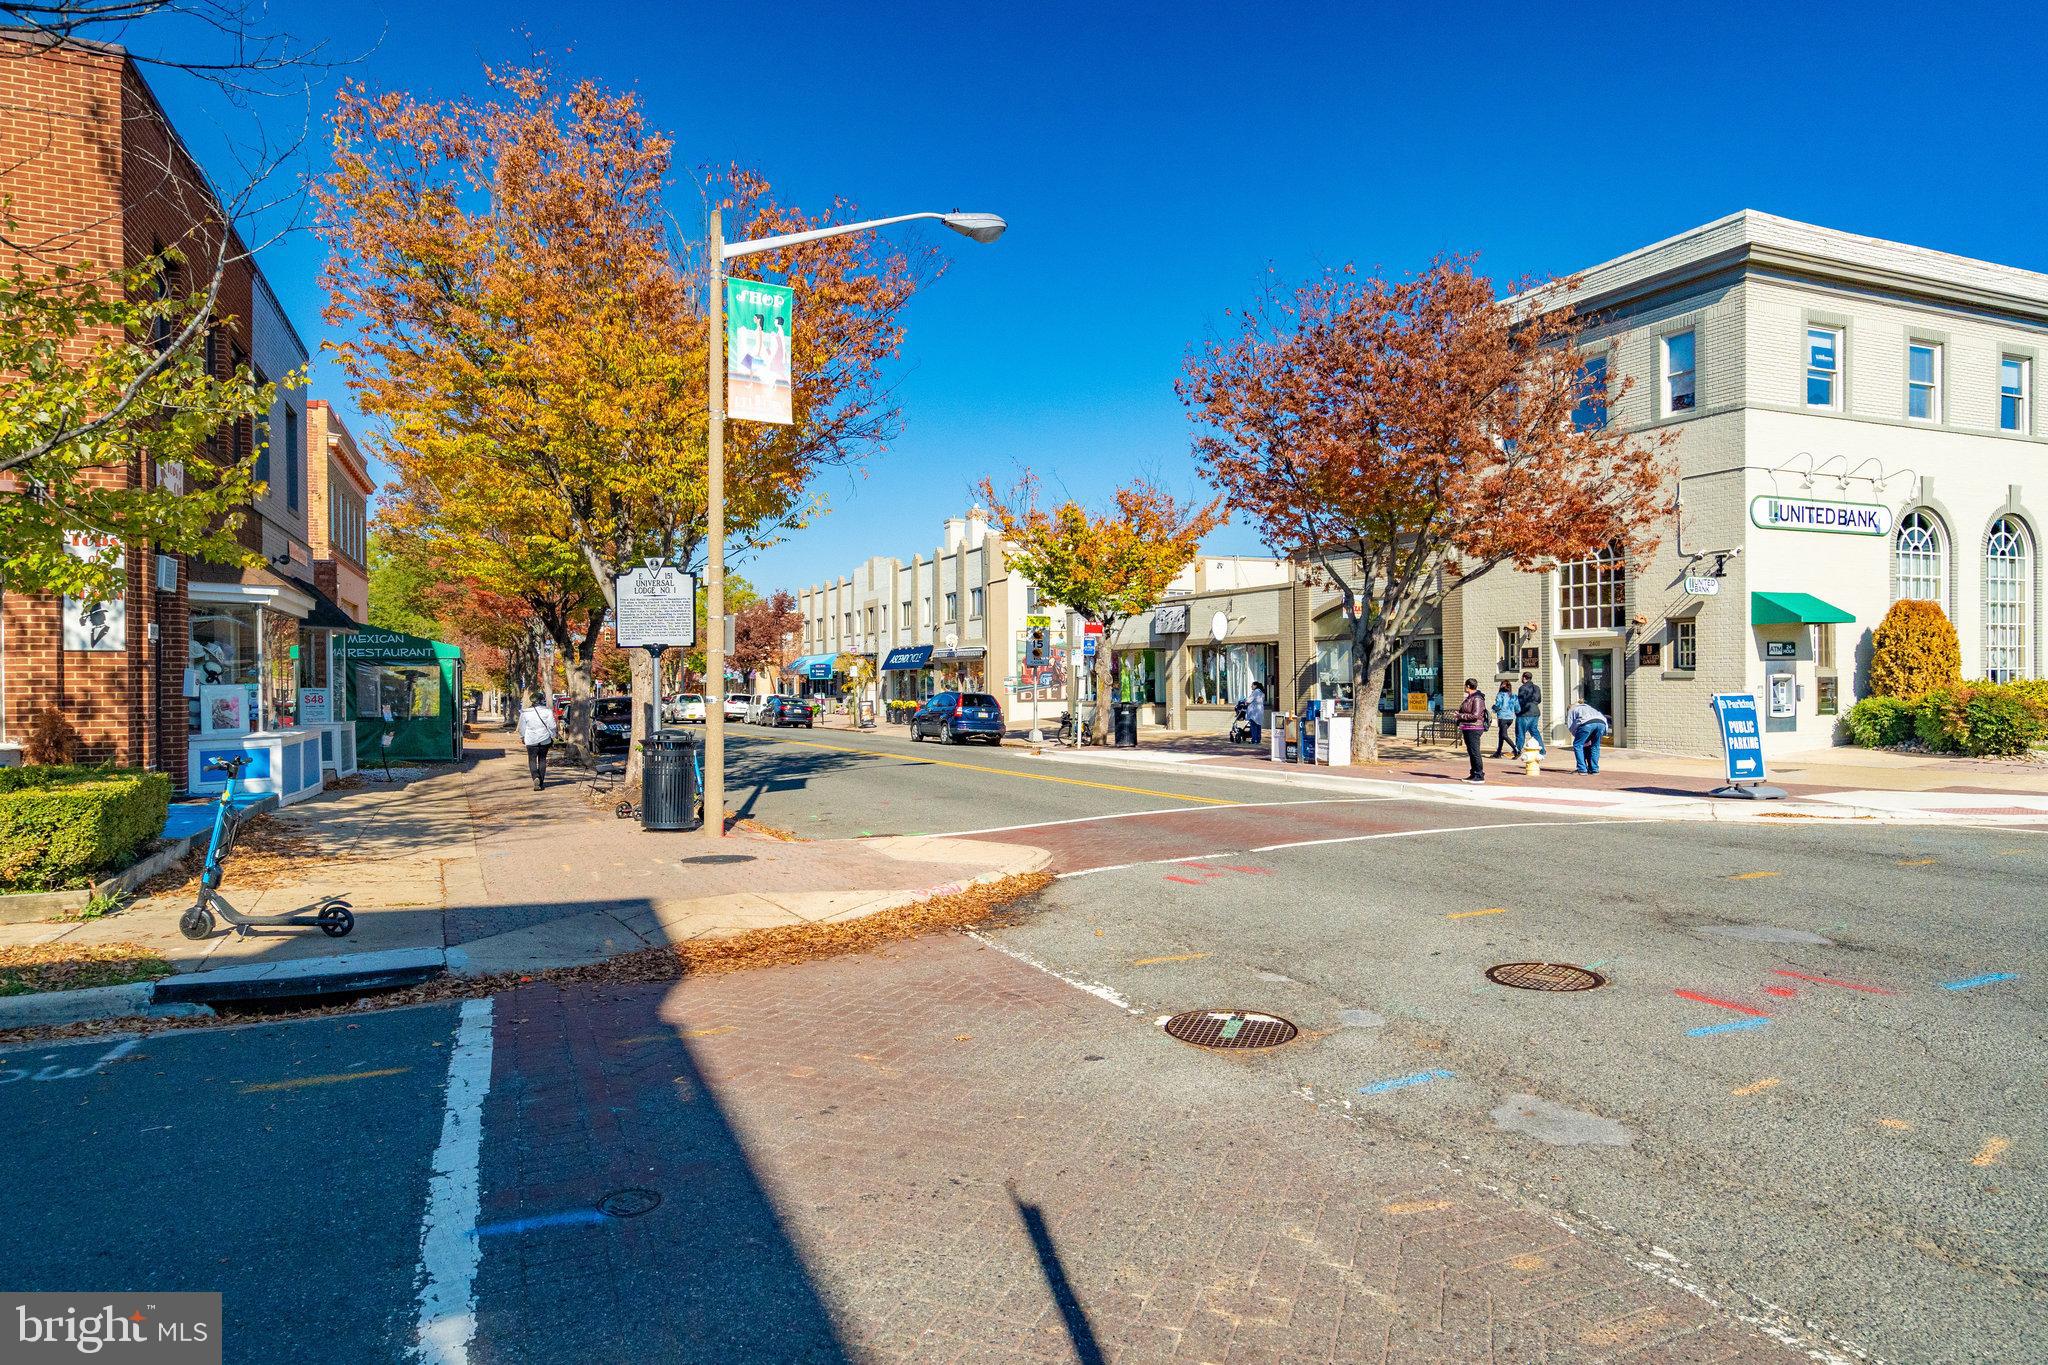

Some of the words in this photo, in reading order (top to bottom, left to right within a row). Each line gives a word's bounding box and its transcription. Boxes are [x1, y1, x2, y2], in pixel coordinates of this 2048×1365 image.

[736, 290, 784, 307] SHOP
[1779, 504, 1836, 525] UNITED
[1837, 509, 1877, 528] BANK
[347, 634, 404, 643] MEXICAN
[347, 648, 433, 657] RESTAURANT
[304, 695, 324, 704] $48
[1726, 699, 1756, 710] Parking
[1728, 720, 1755, 733] PUBLIC
[1729, 736, 1760, 749] PARKING
